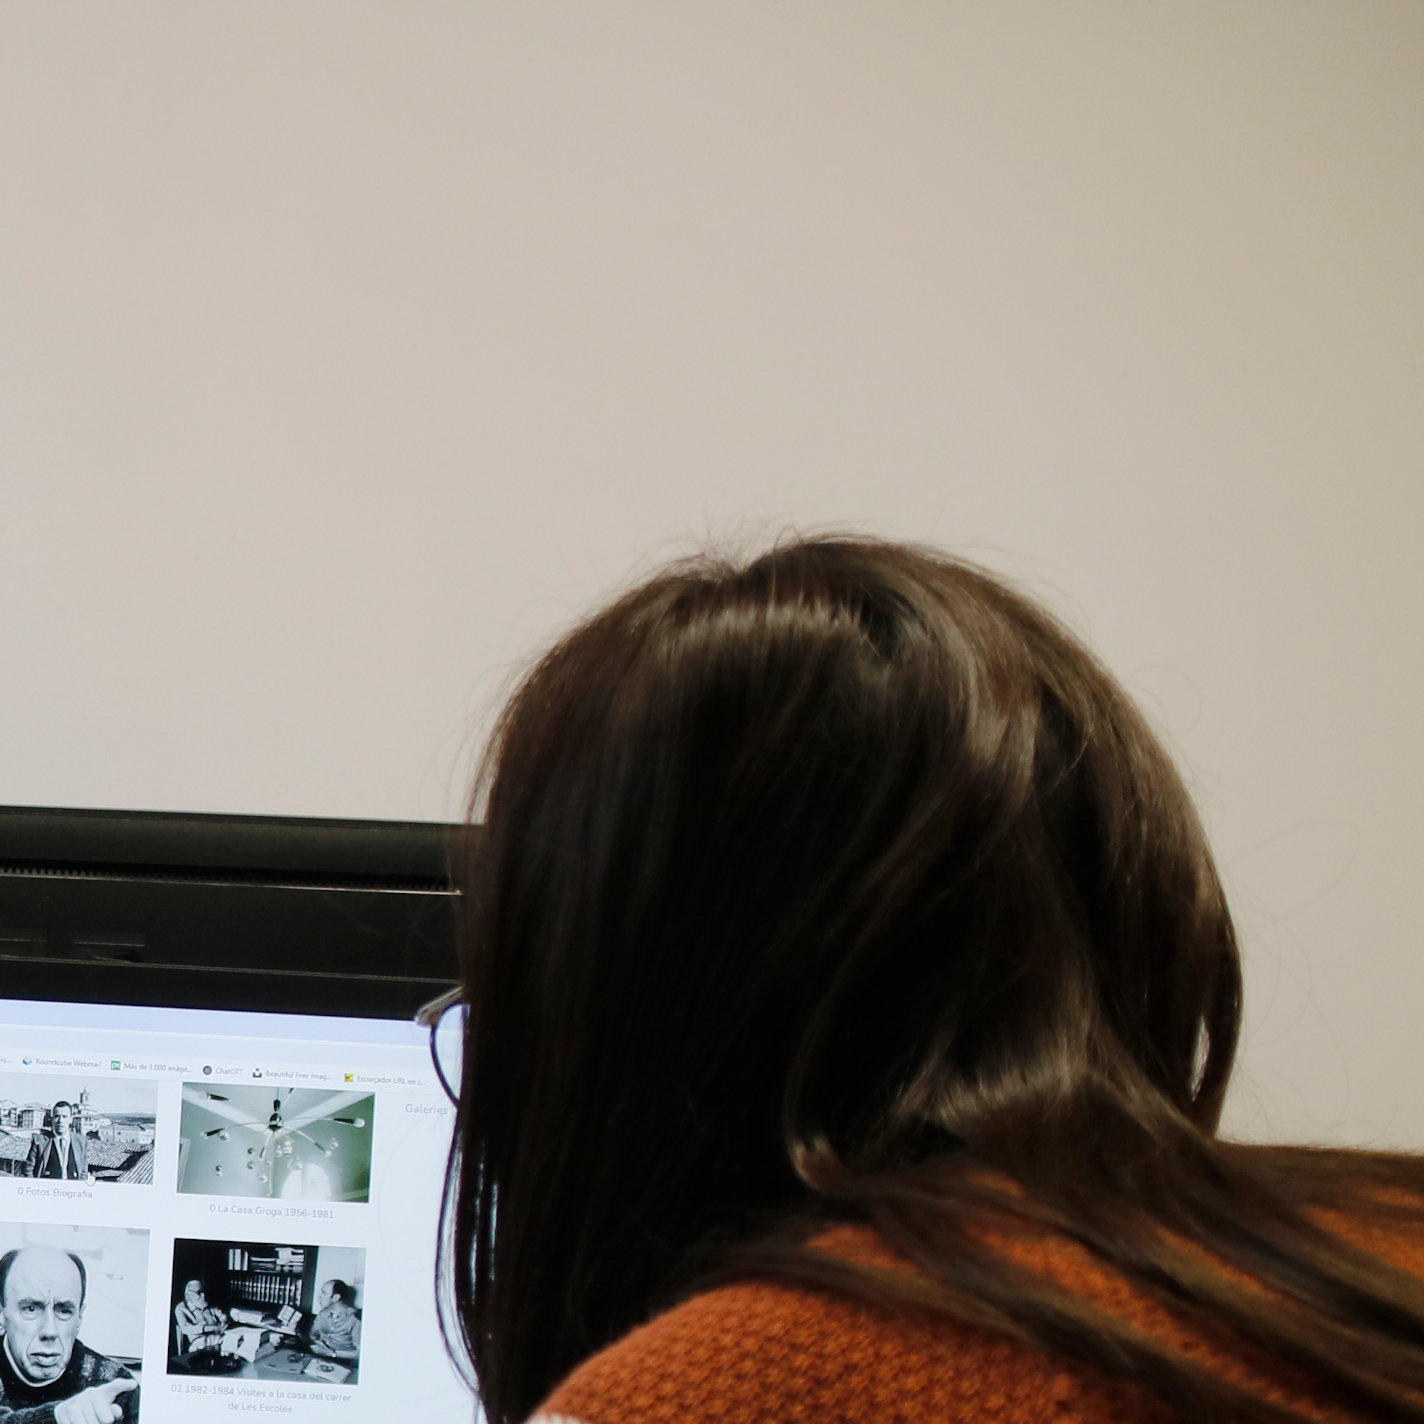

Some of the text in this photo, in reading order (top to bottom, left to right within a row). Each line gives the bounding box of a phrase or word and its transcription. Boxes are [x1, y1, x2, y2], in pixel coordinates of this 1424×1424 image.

[35, 1057, 101, 1068] Roundcube Webmail
[139, 1063, 148, 1071] de
[265, 1069, 294, 1079] Beautiful
[295, 1071, 310, 1079] Free
[405, 1103, 449, 1116] Galeries
[17, 1186, 93, 1199] 0 Fotos Biografia
[209, 1203, 334, 1219] 0 La Casa Groga 1956-1981
[170, 1384, 183, 1393] 02
[185, 1385, 235, 1396] 1982-1984
[237, 1388, 267, 1398] Visites
[276, 1389, 285, 1399] la
[309, 1392, 324, 1401] del
[227, 1402, 293, 1413] de Les Escoles
